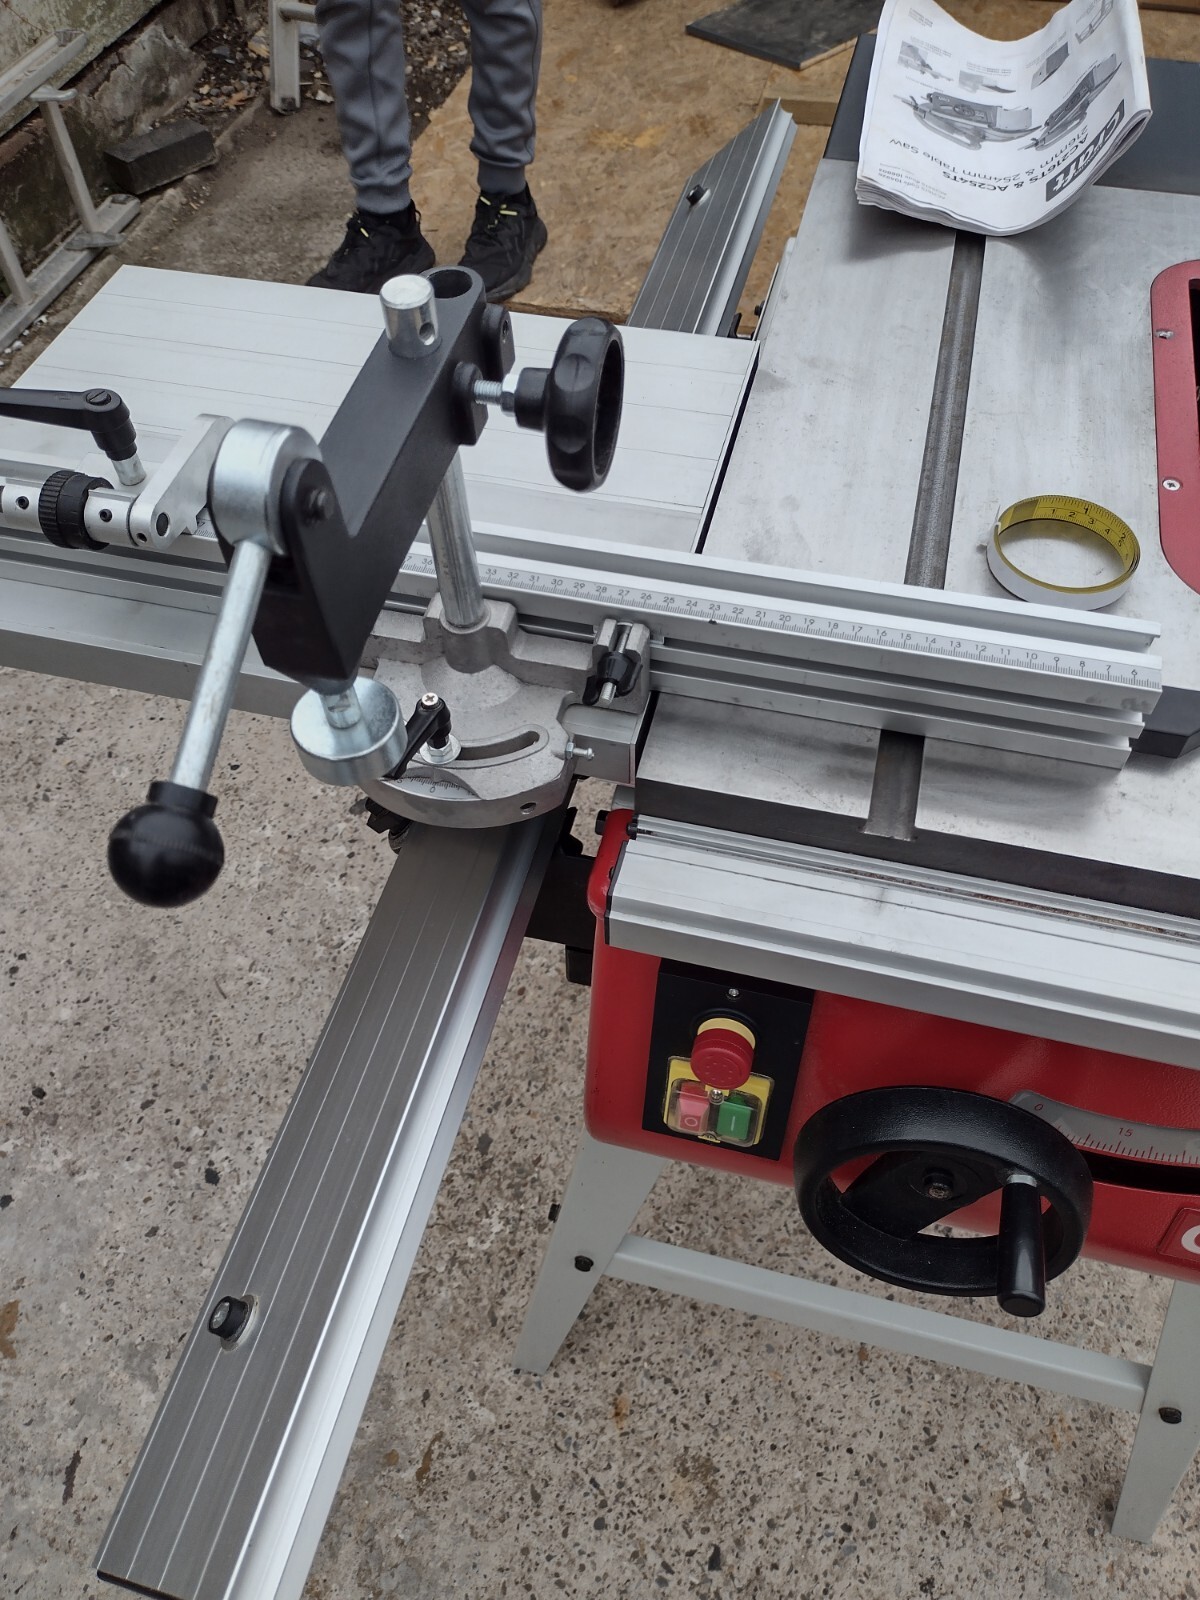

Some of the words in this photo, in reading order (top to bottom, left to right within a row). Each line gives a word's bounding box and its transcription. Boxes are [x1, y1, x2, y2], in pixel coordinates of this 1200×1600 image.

[889, 138, 919, 154] Saw
[1053, 111, 1120, 192] Craft
[922, 151, 958, 173] Table
[1029, 132, 1089, 184] AC216TS
[942, 171, 1008, 192] AC254TS
[422, 558, 433, 566] 36
[486, 568, 498, 576] 33
[508, 571, 520, 579] 32
[529, 574, 540, 582] 31
[551, 578, 563, 586] 30
[573, 581, 585, 589] 29
[595, 585, 607, 593] 28
[618, 589, 630, 597] 27
[640, 592, 652, 600] 26
[663, 596, 675, 604] 25
[709, 603, 721, 611] 23
[732, 606, 744, 615] 22
[755, 610, 767, 618] 21
[779, 614, 791, 622] 20
[804, 617, 815, 625] 19
[828, 621, 839, 629] 18
[852, 625, 863, 633] 17
[876, 628, 887, 637] 16
[901, 632, 912, 640] 15
[925, 636, 937, 644] 14
[950, 640, 962, 648] 13
[975, 644, 987, 652] 12
[1001, 648, 1011, 656] 11
[1026, 652, 1038, 660] 10
[1118, 1127, 1133, 1137] 15
